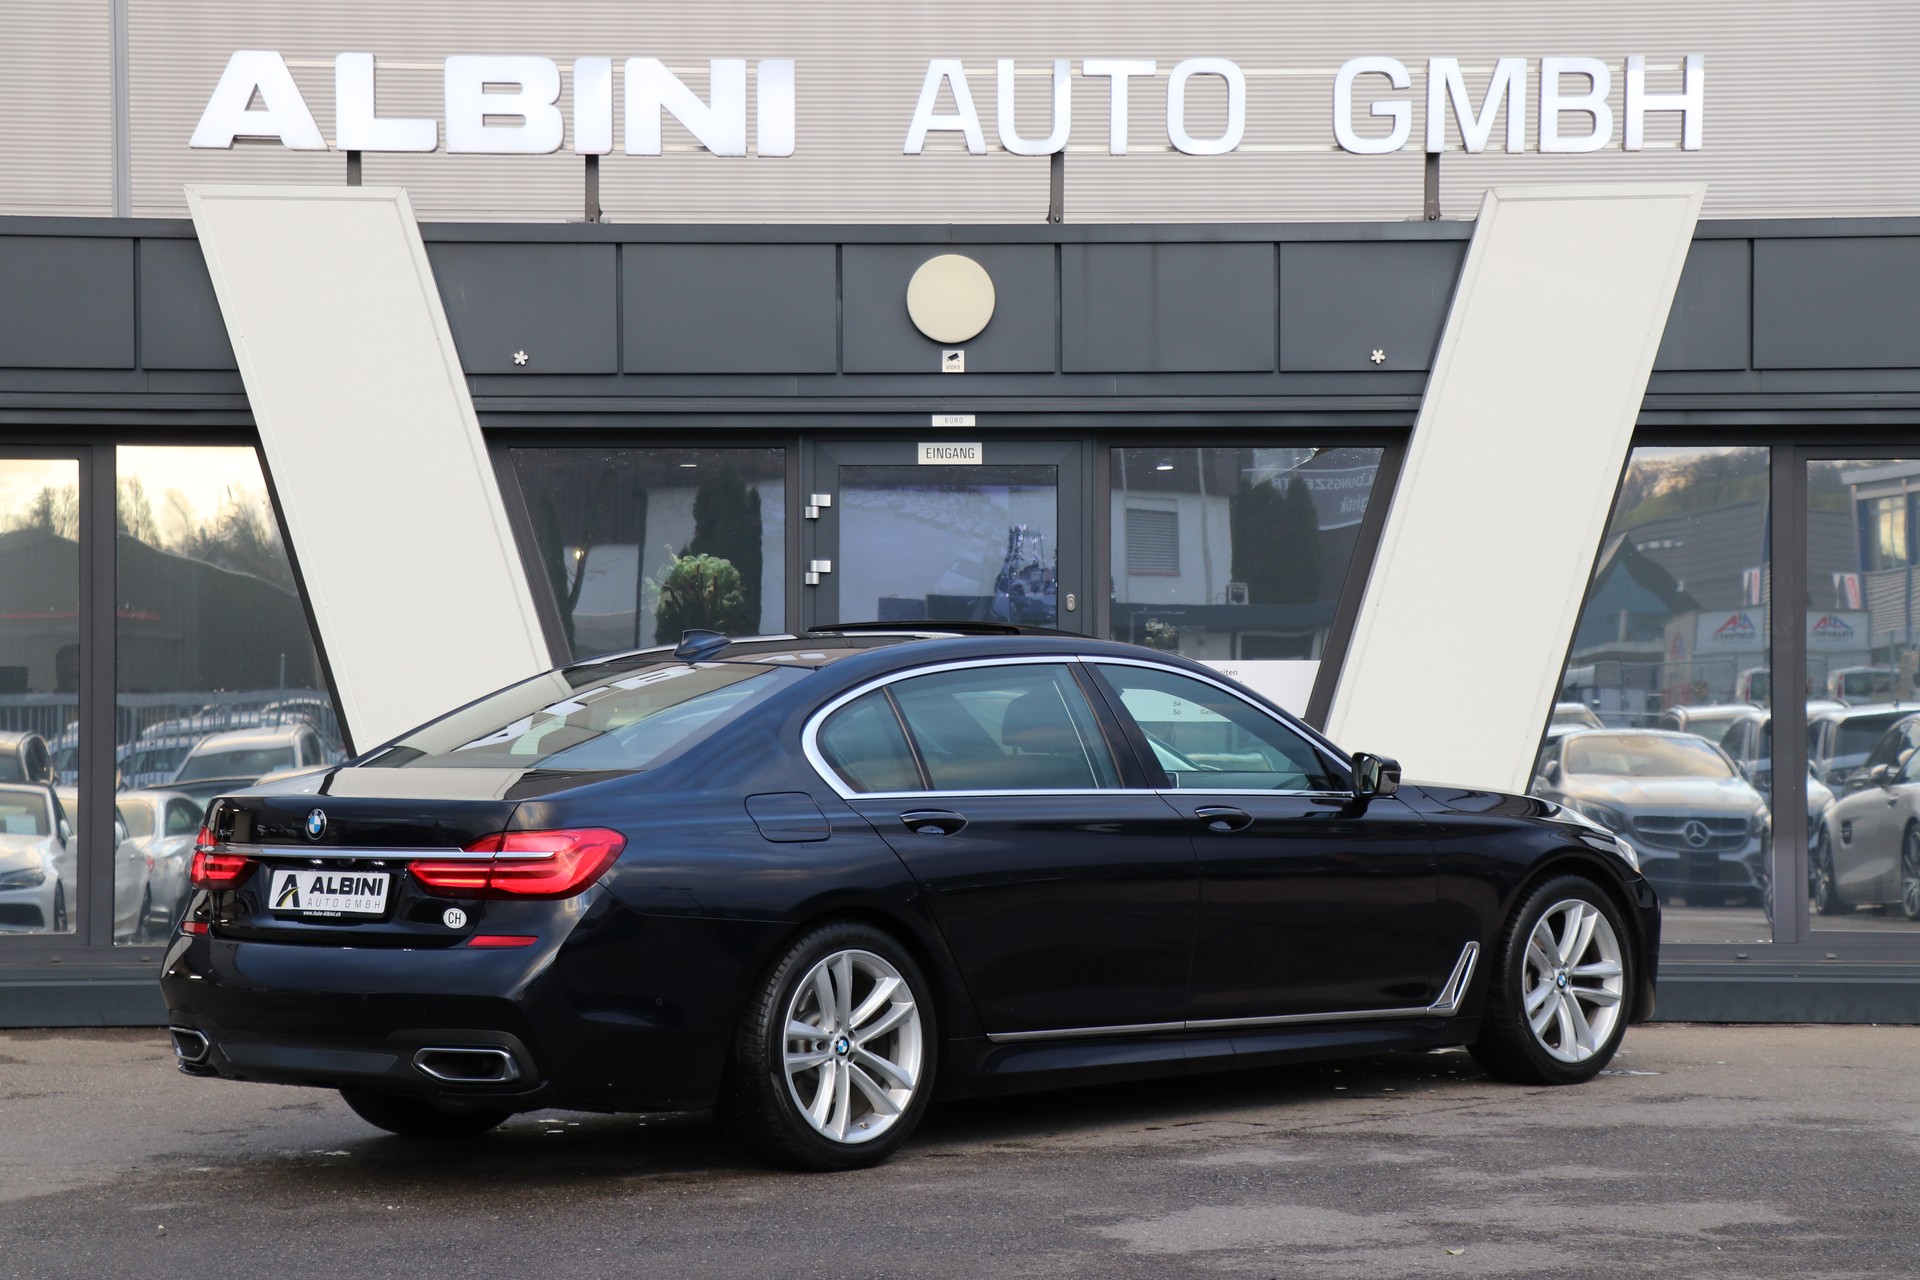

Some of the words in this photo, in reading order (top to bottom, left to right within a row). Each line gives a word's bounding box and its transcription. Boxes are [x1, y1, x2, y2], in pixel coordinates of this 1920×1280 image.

[188, 50, 796, 158] ALBINI
[903, 57, 1247, 156] AUTO
[1331, 53, 1706, 155] GMBH
[925, 447, 975, 459] EINGANG
[309, 876, 384, 896] ALBINI
[306, 897, 339, 908] AUTO
[345, 898, 381, 909] GMBH
[448, 911, 462, 925] CH
